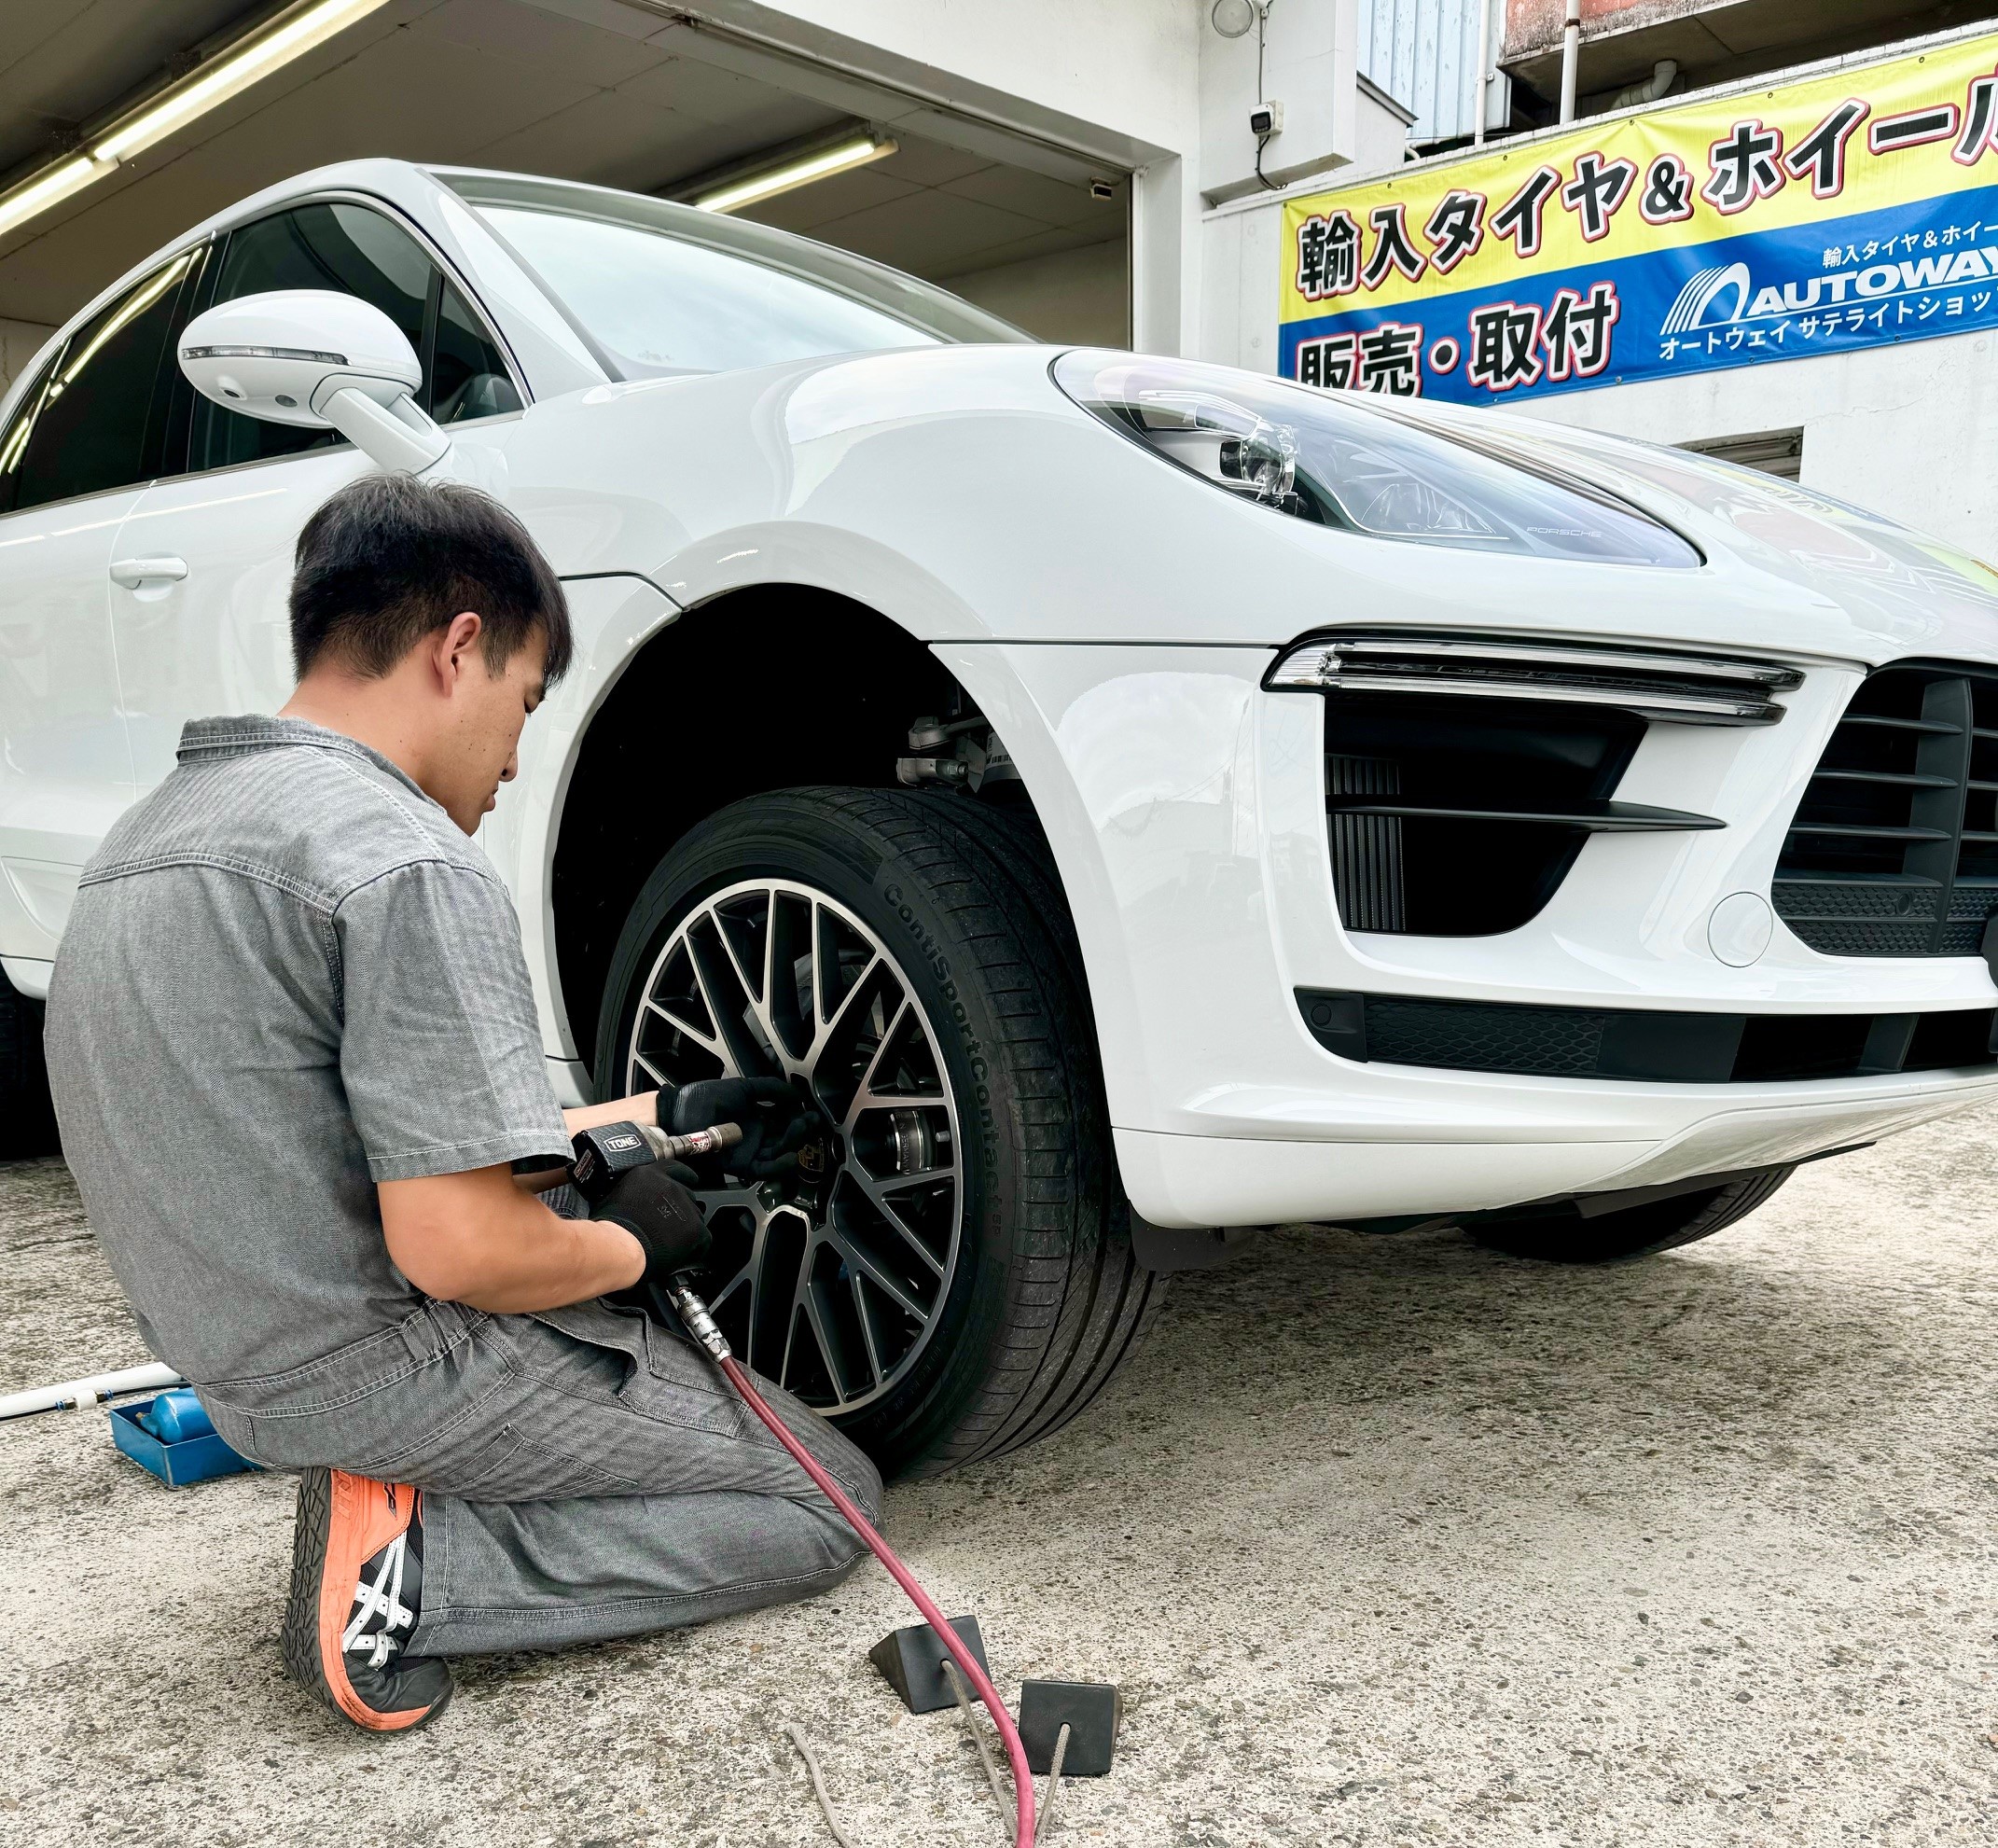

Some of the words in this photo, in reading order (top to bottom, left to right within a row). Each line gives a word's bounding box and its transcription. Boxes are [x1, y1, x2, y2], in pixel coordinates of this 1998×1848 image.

[1798, 285, 1998, 340] サテライトショッ
[1527, 526, 1603, 537] PORSCHE
[882, 882, 1003, 1209] ContiSportContact
[607, 1136, 638, 1149] TONE
